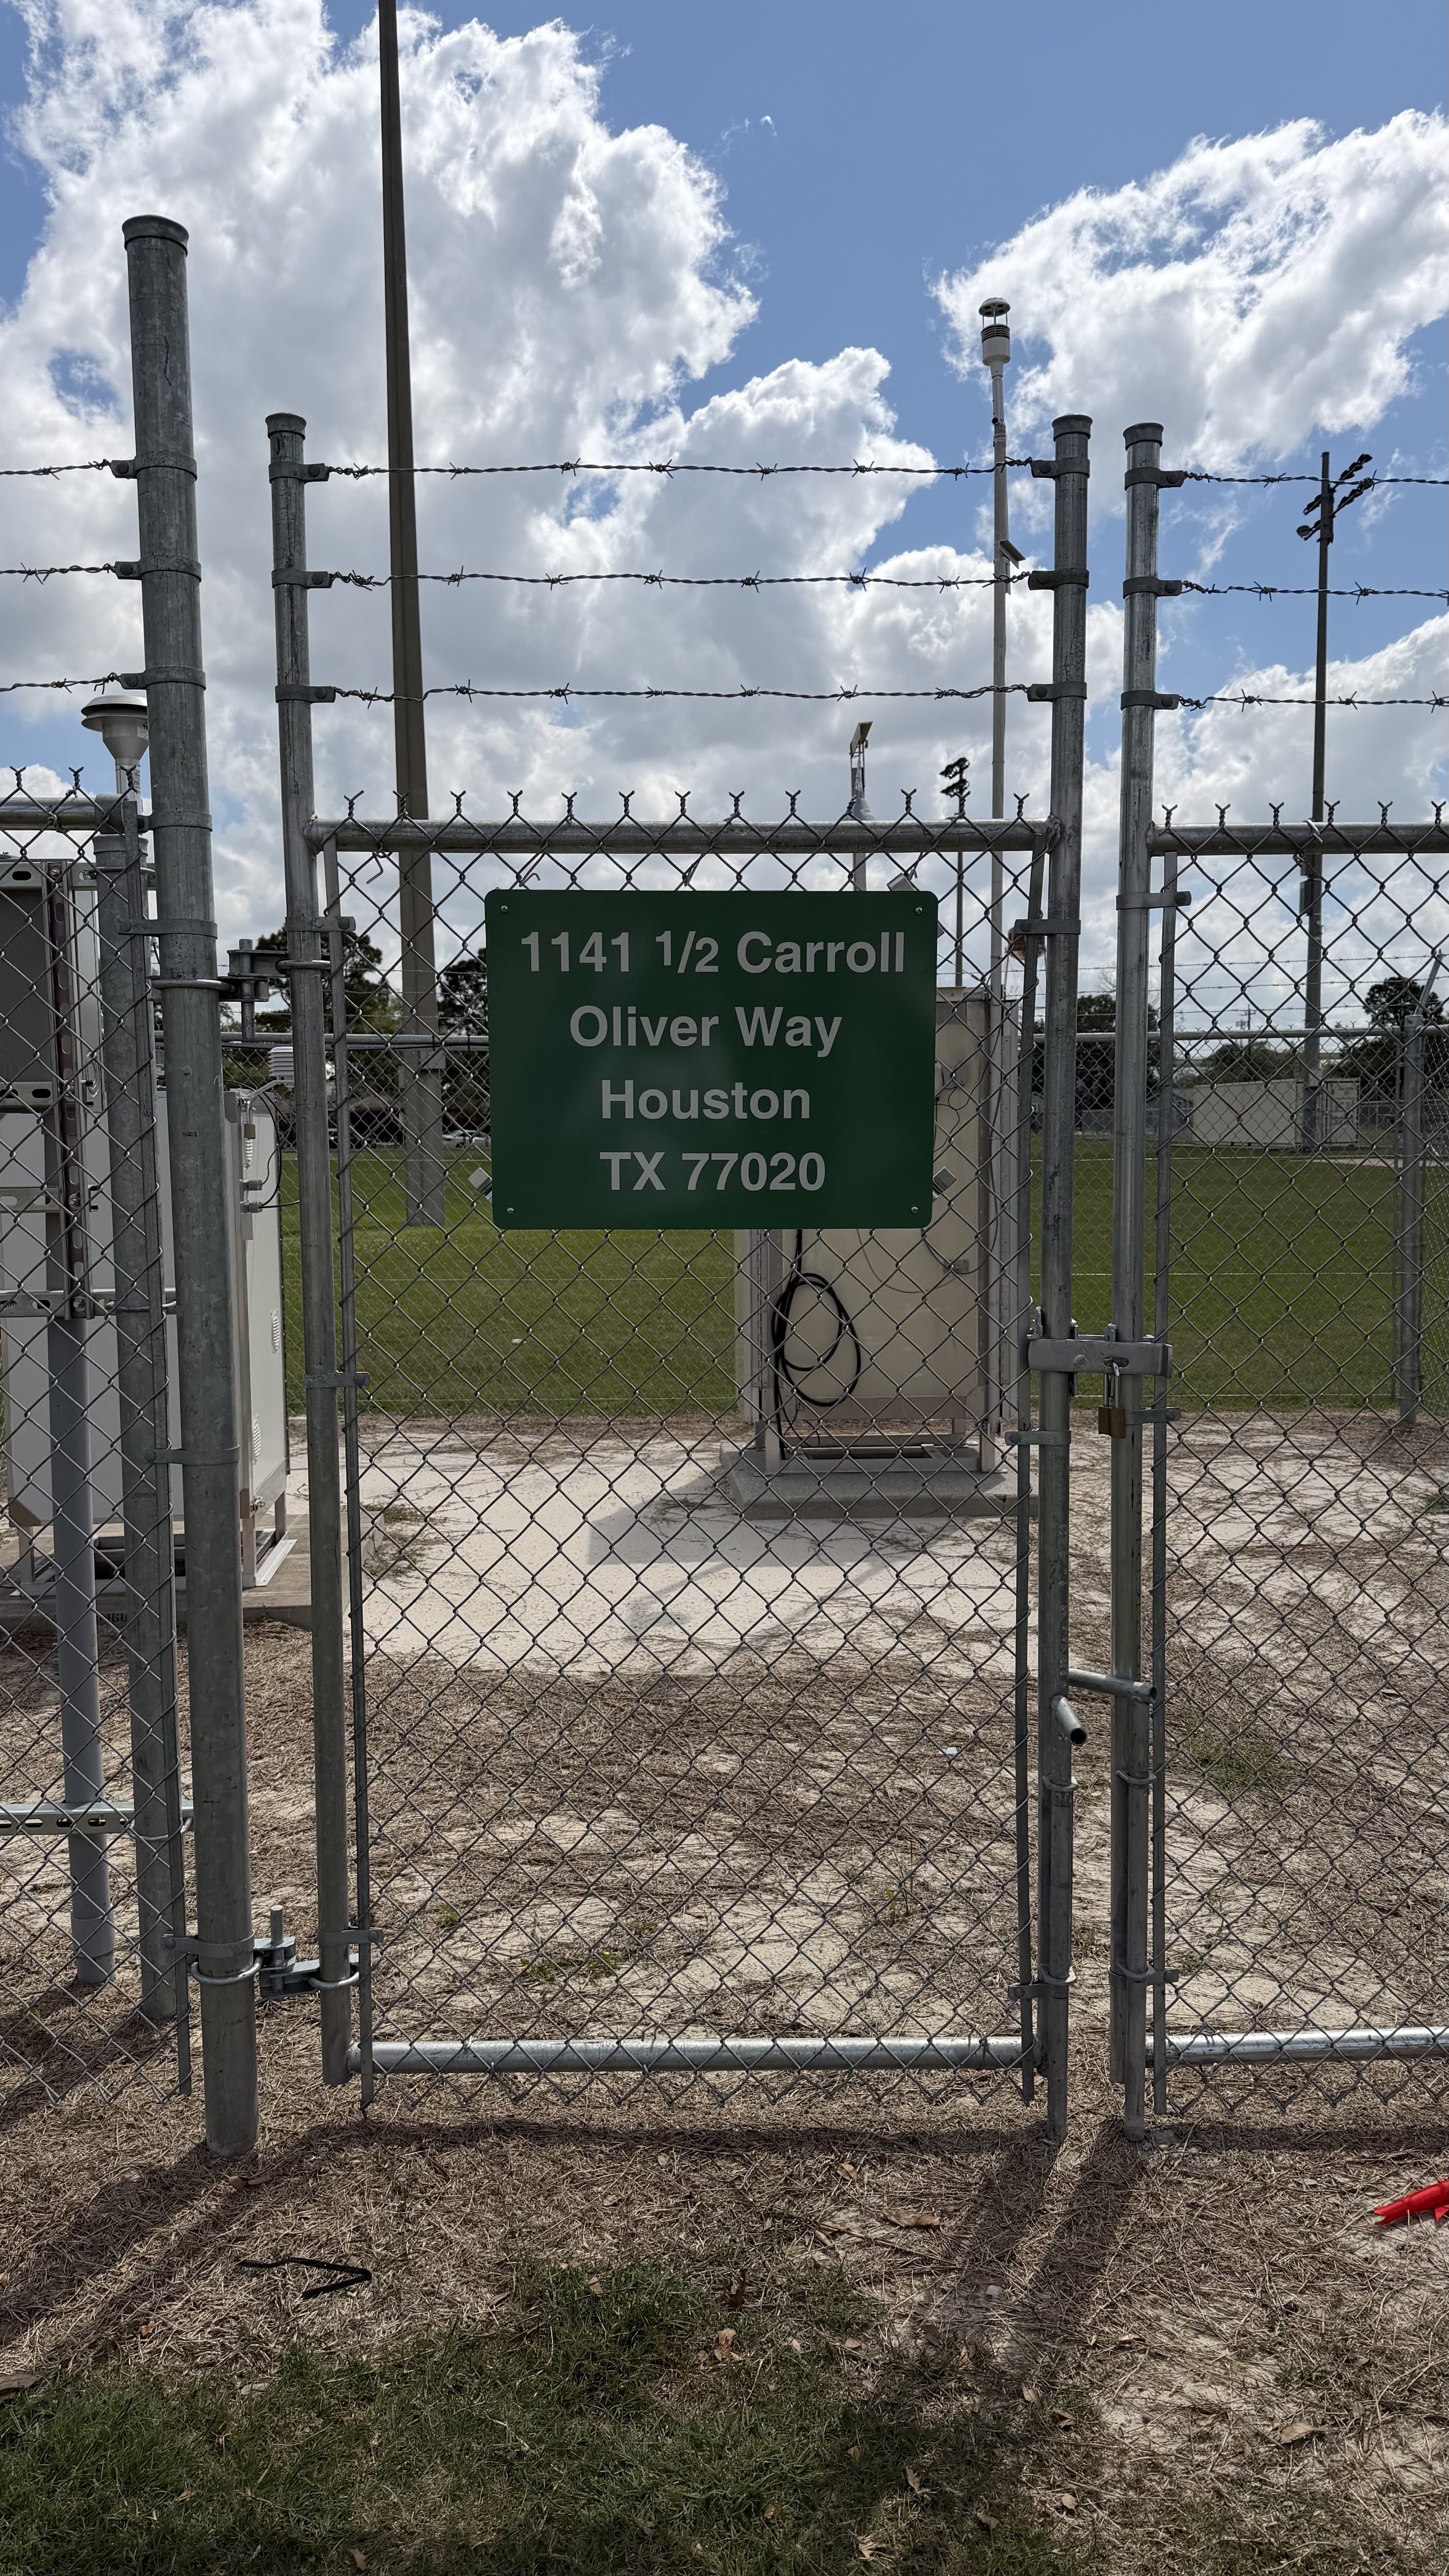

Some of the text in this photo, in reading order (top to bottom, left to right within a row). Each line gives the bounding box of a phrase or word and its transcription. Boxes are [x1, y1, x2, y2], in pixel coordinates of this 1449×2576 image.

[520, 930, 905, 973] 1141 1/2 Carroll
[569, 1005, 843, 1058] Oliver Way
[601, 1079, 810, 1119] Houston
[599, 1151, 826, 1191] TX 77020
